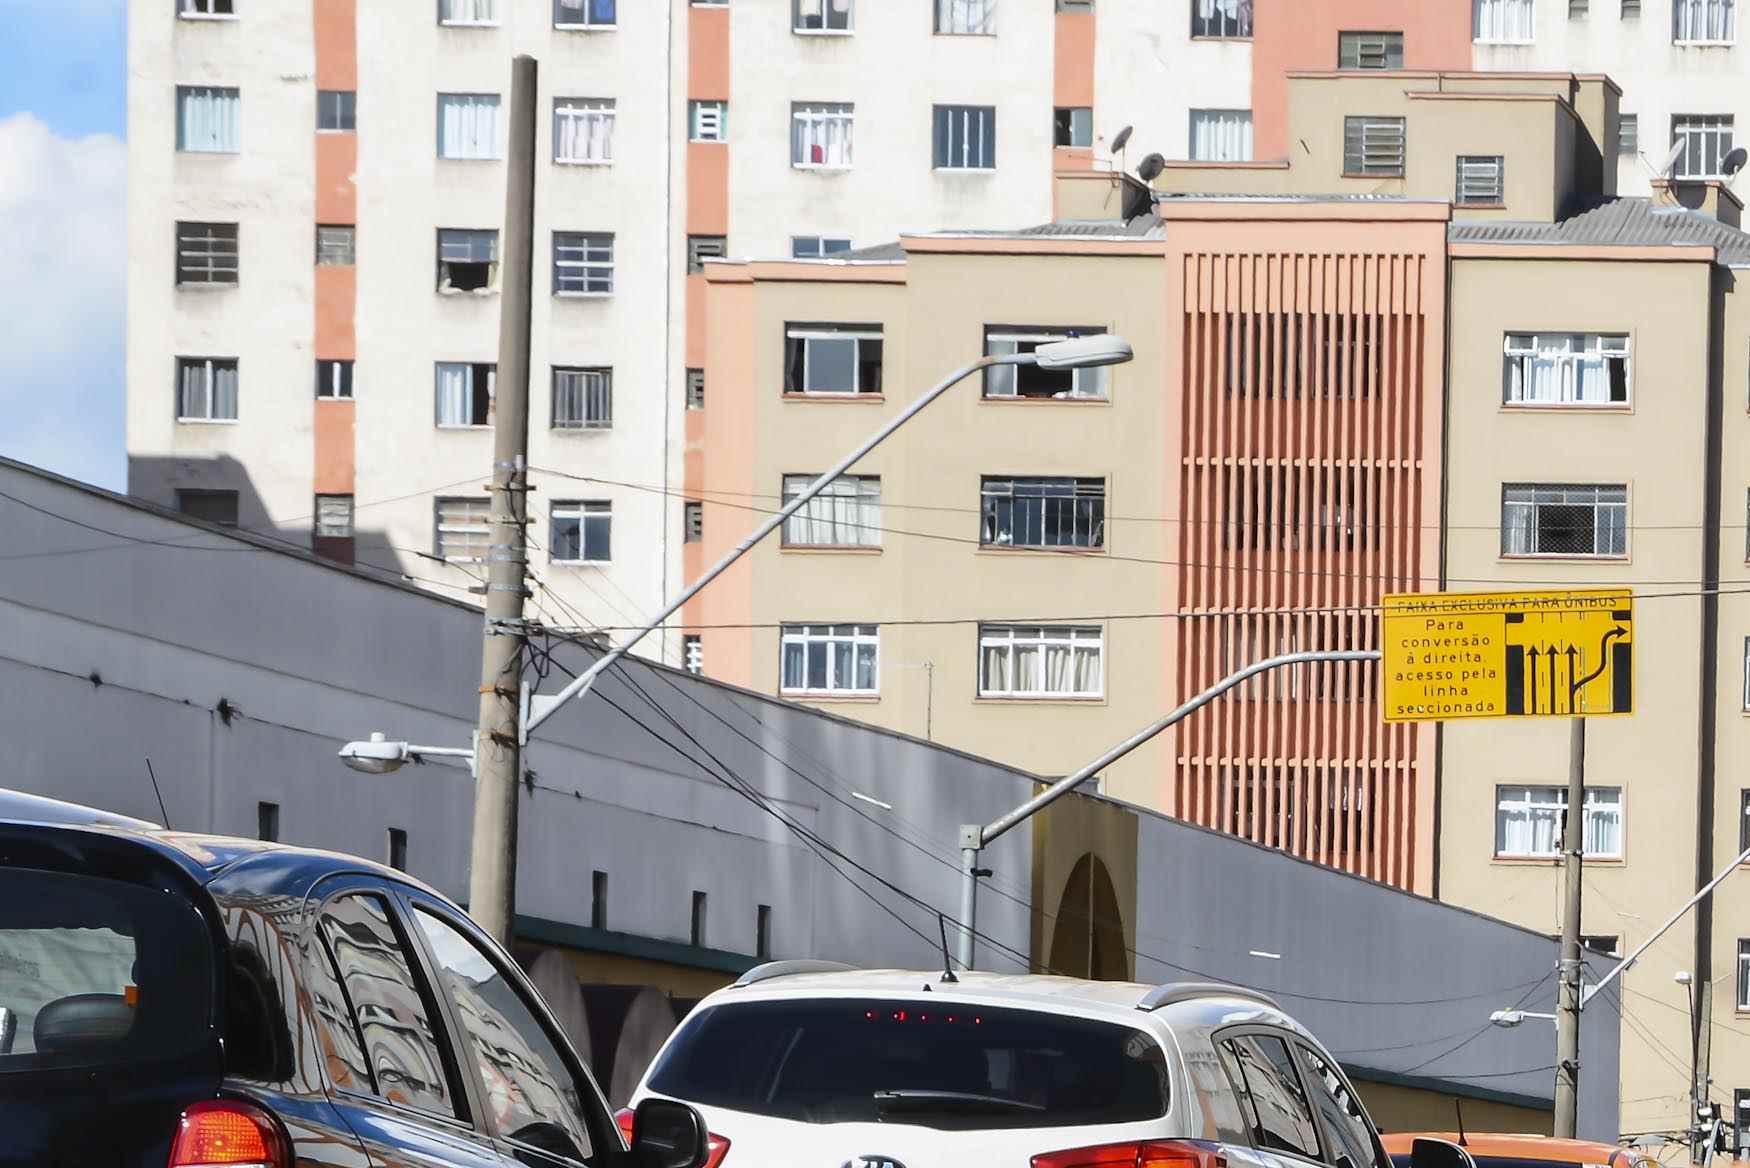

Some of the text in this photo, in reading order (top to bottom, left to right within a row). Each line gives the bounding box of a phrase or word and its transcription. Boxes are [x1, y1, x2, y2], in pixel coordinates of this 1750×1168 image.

[1523, 597, 1560, 609] PARA
[1426, 619, 1464, 632] Para
[1401, 634, 1490, 649] conversão
[1406, 651, 1415, 665] à
[1395, 668, 1496, 682] acesso pela
[1424, 685, 1468, 697] linha
[1397, 701, 1495, 714] seccionada
